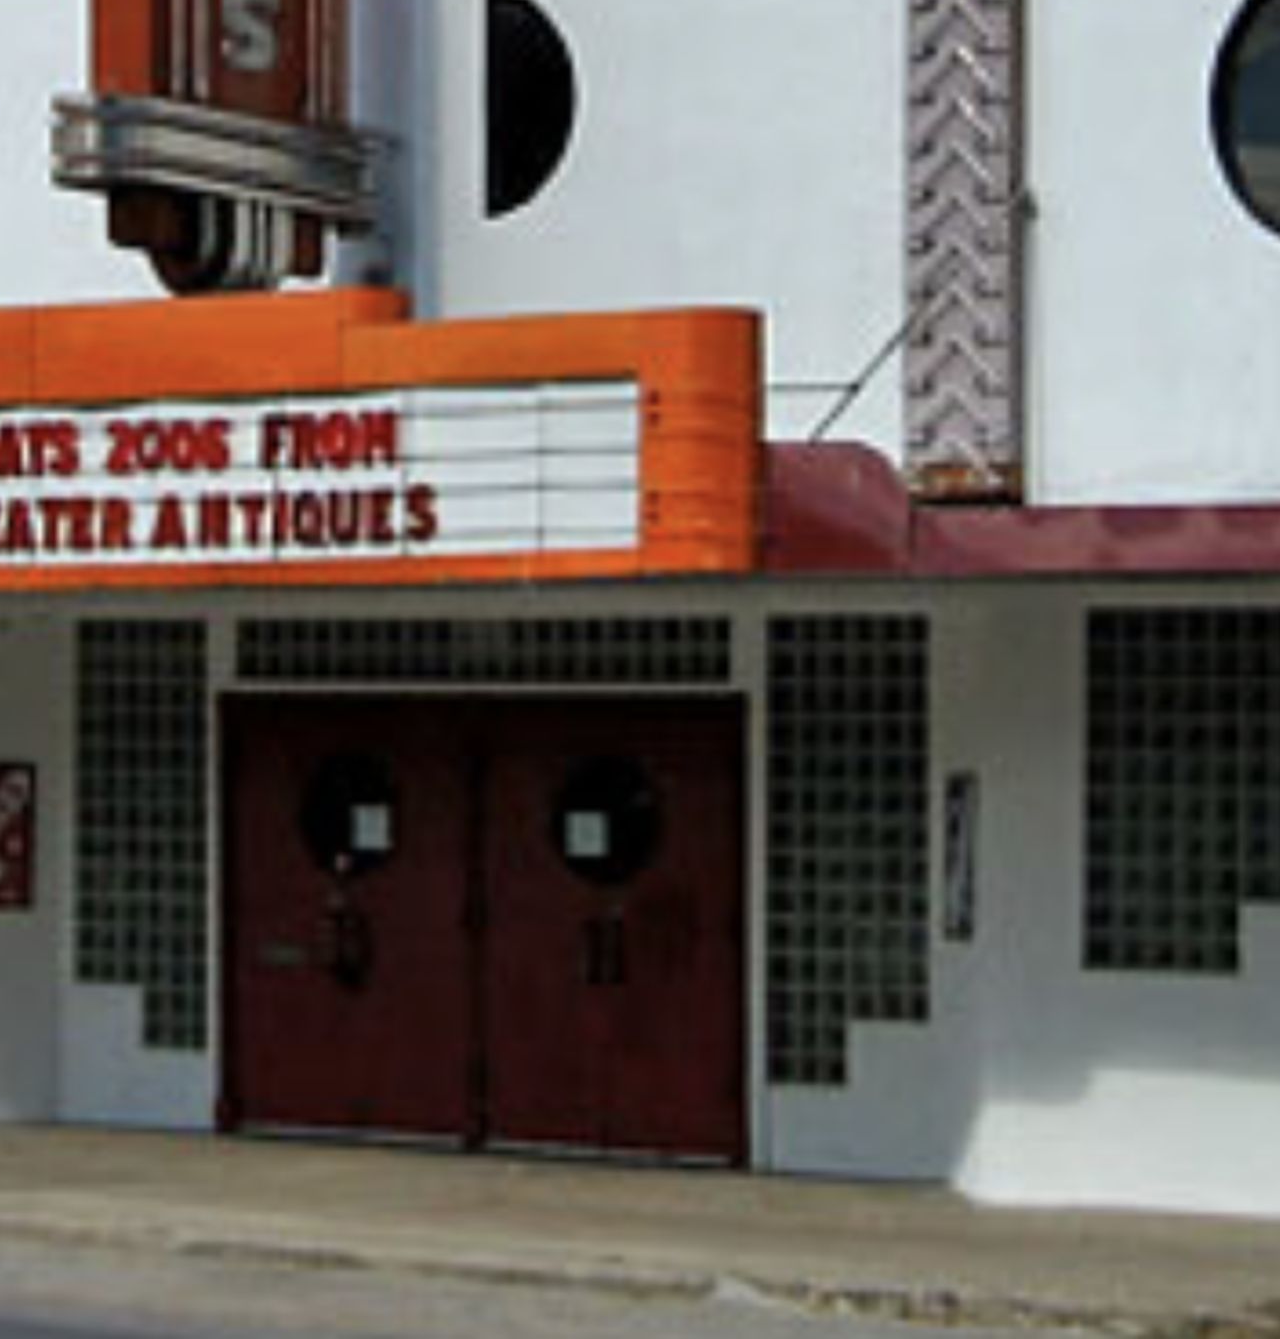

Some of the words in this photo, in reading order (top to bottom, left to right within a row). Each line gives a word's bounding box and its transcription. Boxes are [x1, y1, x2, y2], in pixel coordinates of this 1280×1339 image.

[105, 419, 231, 476] 2006
[261, 409, 397, 470] FROM
[151, 482, 439, 551] ANTIQUES
